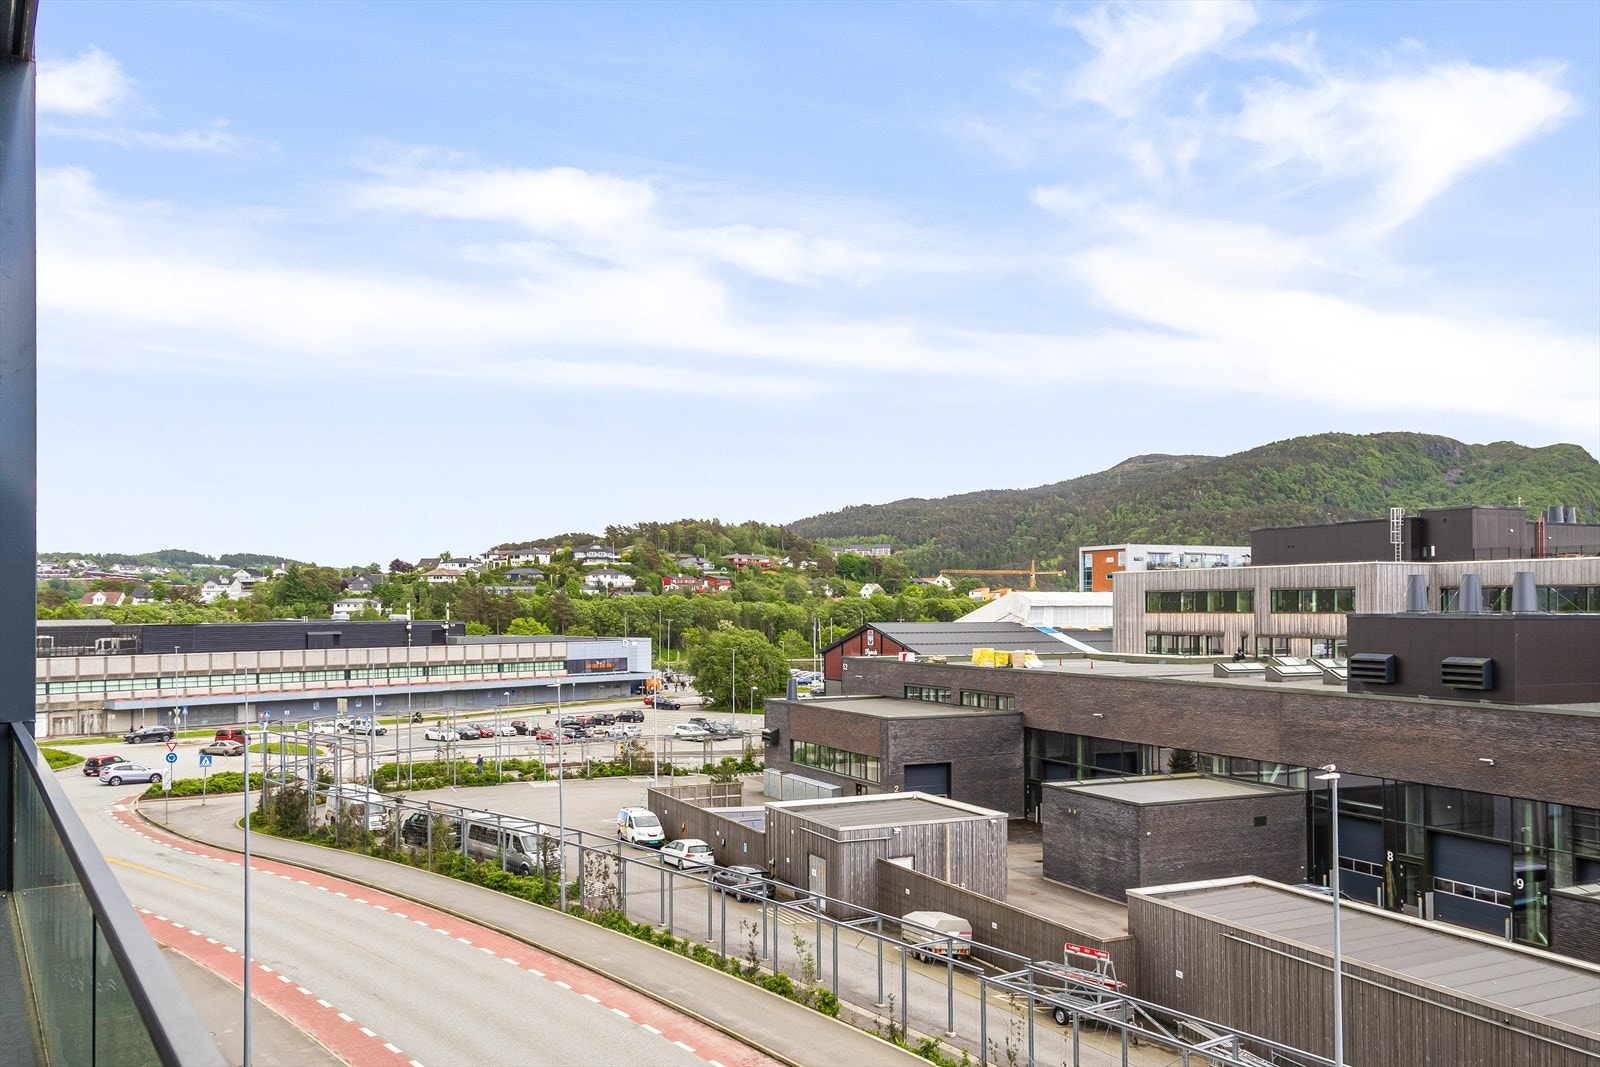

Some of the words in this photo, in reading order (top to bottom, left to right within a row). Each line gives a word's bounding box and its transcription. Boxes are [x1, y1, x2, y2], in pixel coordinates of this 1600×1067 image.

[894, 785, 899, 793] 2
[1387, 851, 1394, 862] 8
[1516, 878, 1524, 890] 9
